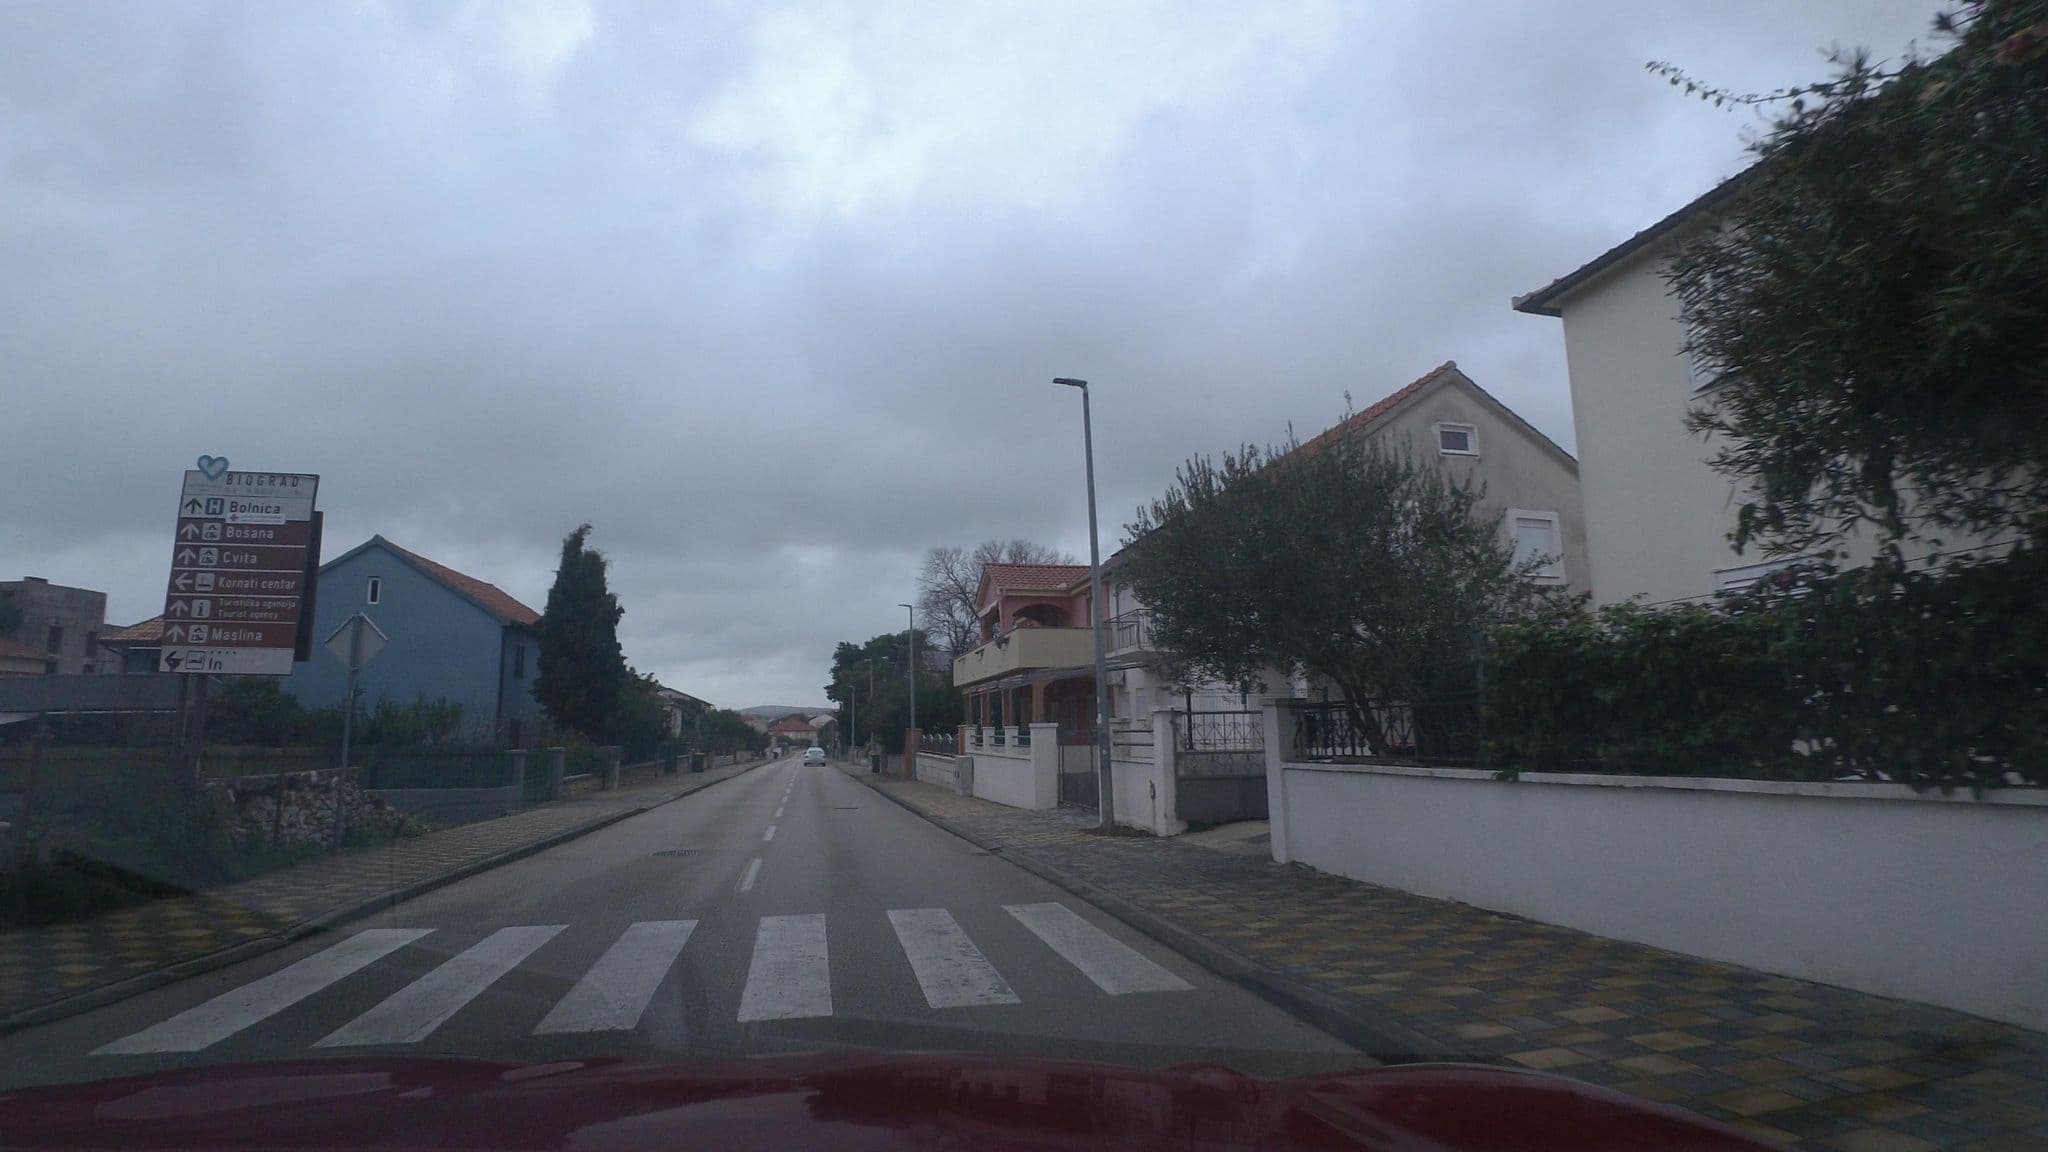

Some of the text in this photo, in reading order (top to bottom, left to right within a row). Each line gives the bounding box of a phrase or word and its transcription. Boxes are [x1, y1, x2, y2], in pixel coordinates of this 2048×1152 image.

[226, 473, 300, 488] BIOGRAD
[229, 501, 281, 514] Bolnica
[223, 551, 257, 564] Cvita
[218, 576, 295, 590] Kornati centar
[217, 609, 278, 620] Tourist agency
[212, 627, 263, 641] Maslina
